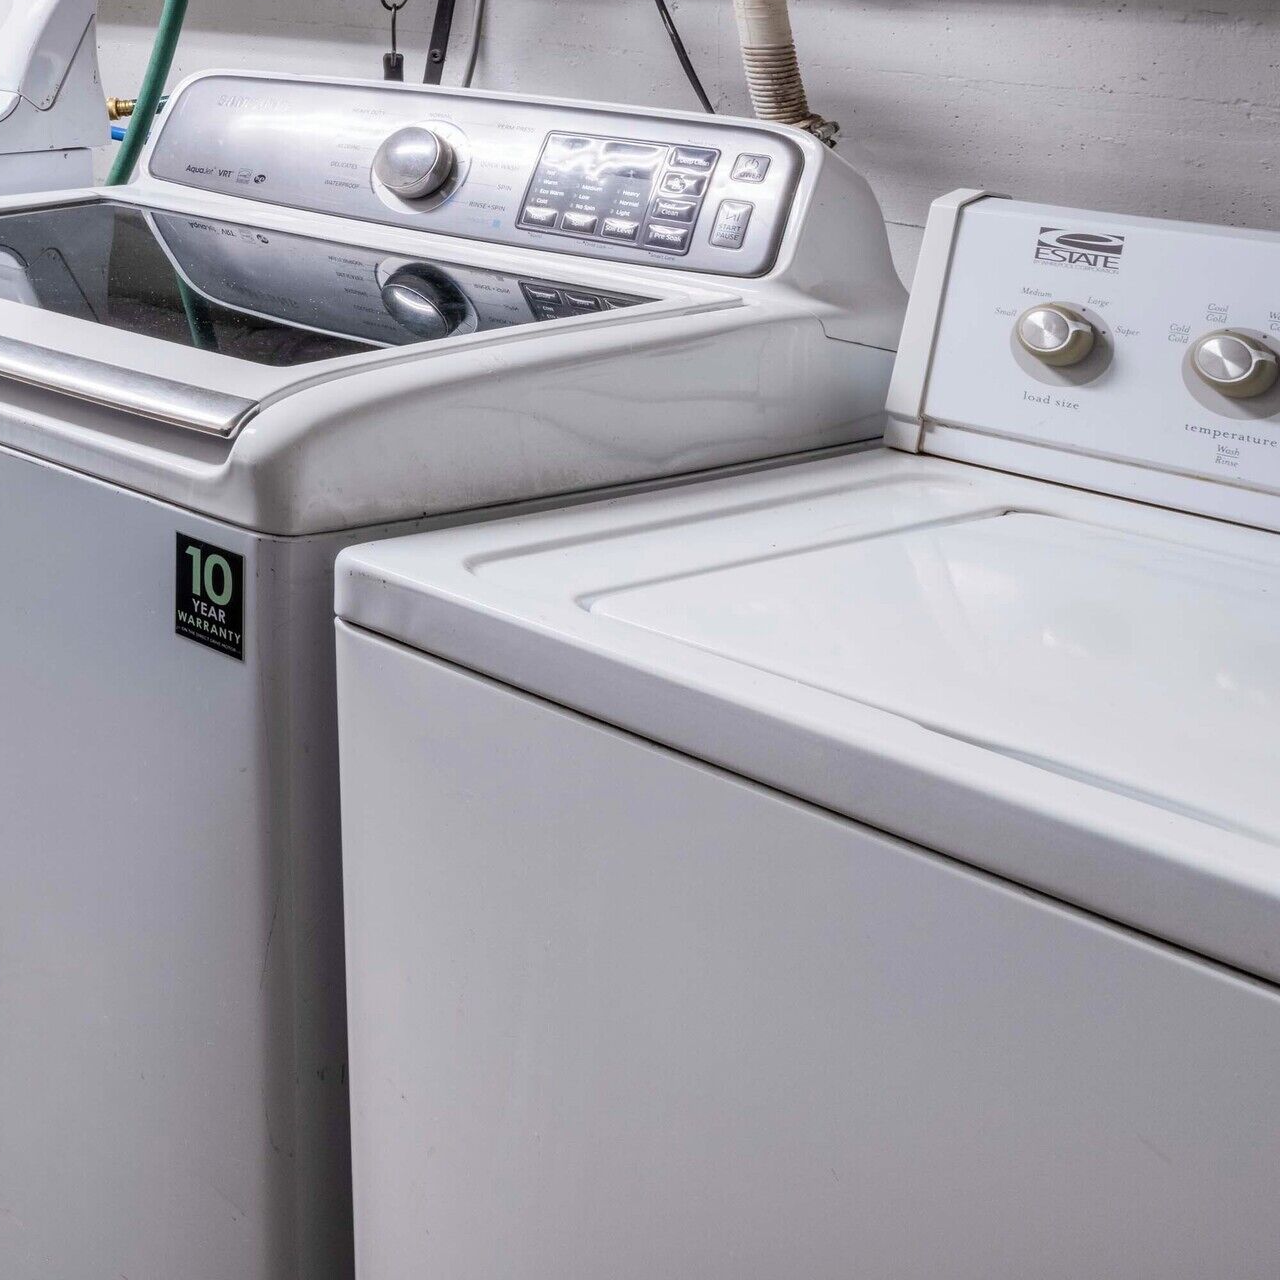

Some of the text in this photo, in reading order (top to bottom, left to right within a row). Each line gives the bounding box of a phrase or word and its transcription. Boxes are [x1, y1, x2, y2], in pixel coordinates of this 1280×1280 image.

[219, 169, 233, 178] VRT
[497, 184, 512, 192] SPIN
[615, 209, 631, 217] Light
[660, 209, 679, 217] Clean
[719, 223, 741, 232] START
[716, 231, 740, 241] PAUSE
[1034, 247, 1121, 270] ESTATE
[1021, 287, 1052, 298] Medium
[1087, 296, 1110, 308] Large
[994, 306, 1018, 318] Small
[1207, 303, 1229, 313] Cool
[1205, 313, 1228, 324] Cold
[1115, 325, 1140, 337] Super
[1169, 323, 1191, 334] Cold
[1168, 334, 1189, 344] Cold
[1023, 390, 1080, 410] load size
[1184, 423, 1278, 448] temperature
[1216, 444, 1240, 456] Wash
[1214, 456, 1239, 469] Rinse
[185, 545, 233, 606] 10
[191, 598, 227, 625] YEAR
[177, 609, 241, 645] WARRANTY
